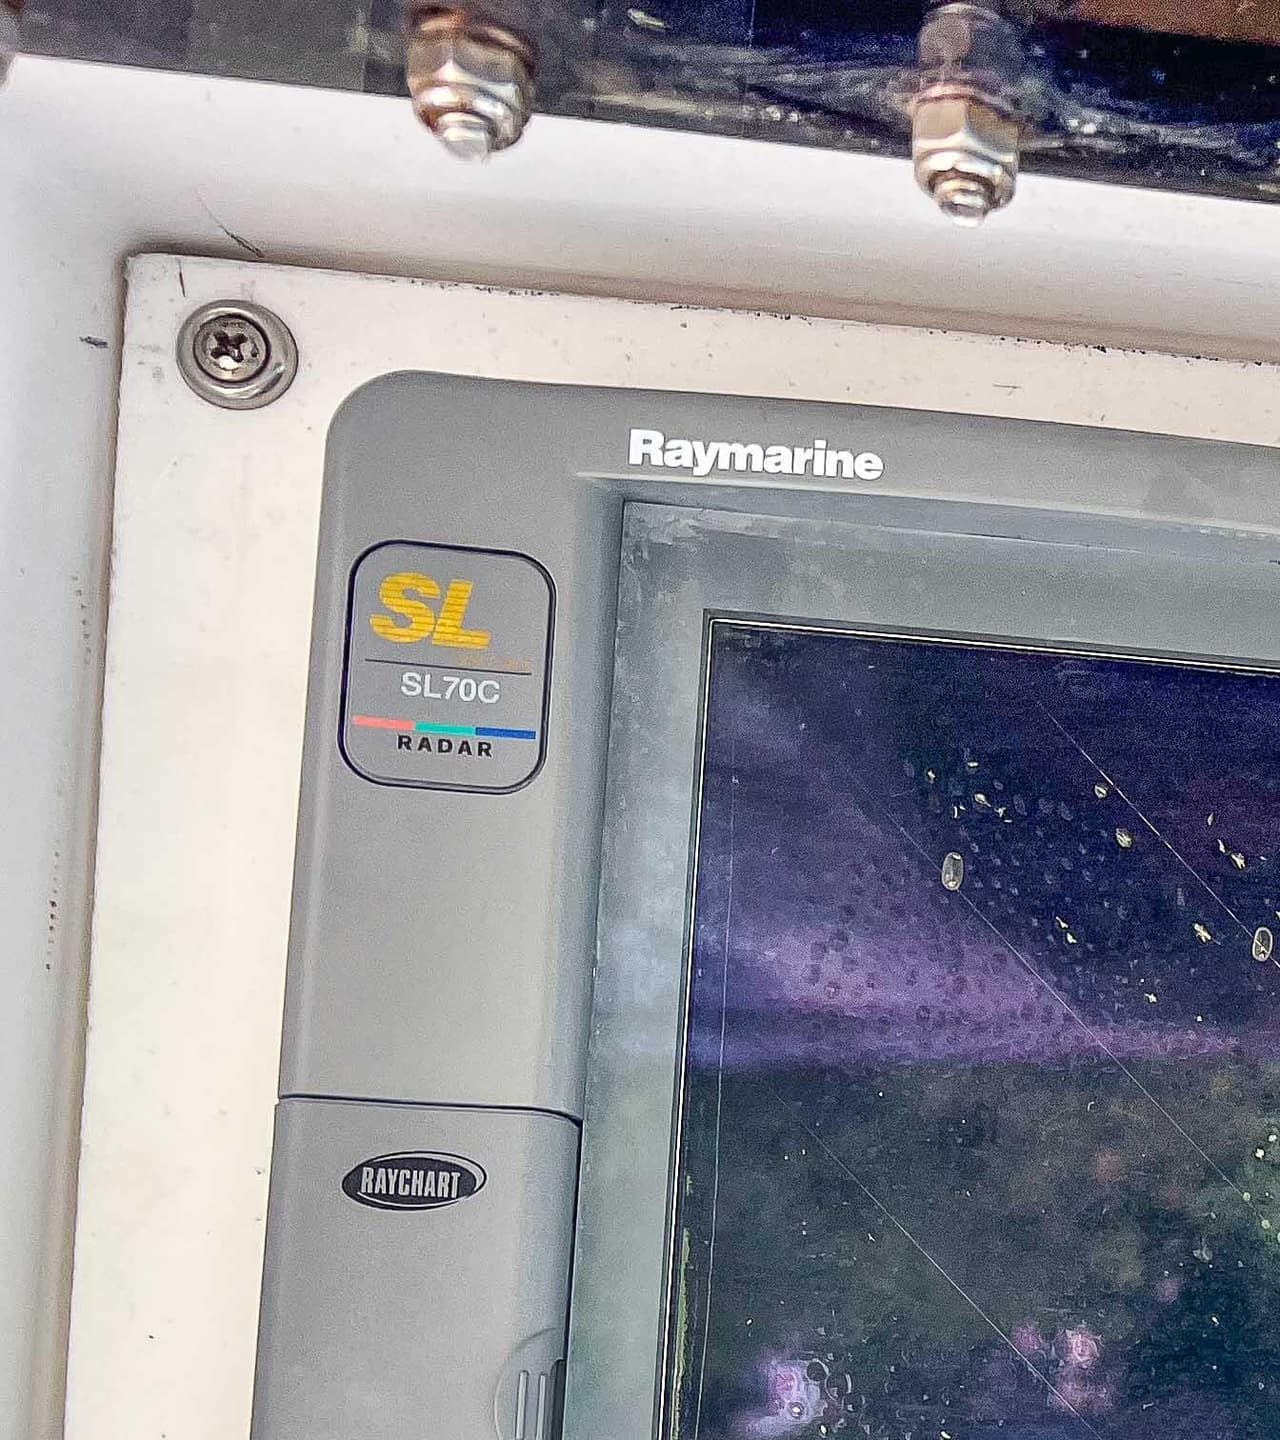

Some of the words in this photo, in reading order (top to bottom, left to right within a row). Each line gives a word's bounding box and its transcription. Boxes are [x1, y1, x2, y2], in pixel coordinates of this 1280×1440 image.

[627, 428, 885, 480] Raymarine
[367, 571, 491, 649] SL
[401, 672, 501, 704] SL70C
[397, 734, 494, 757] RADAR
[360, 1166, 461, 1198] RAYCHART
